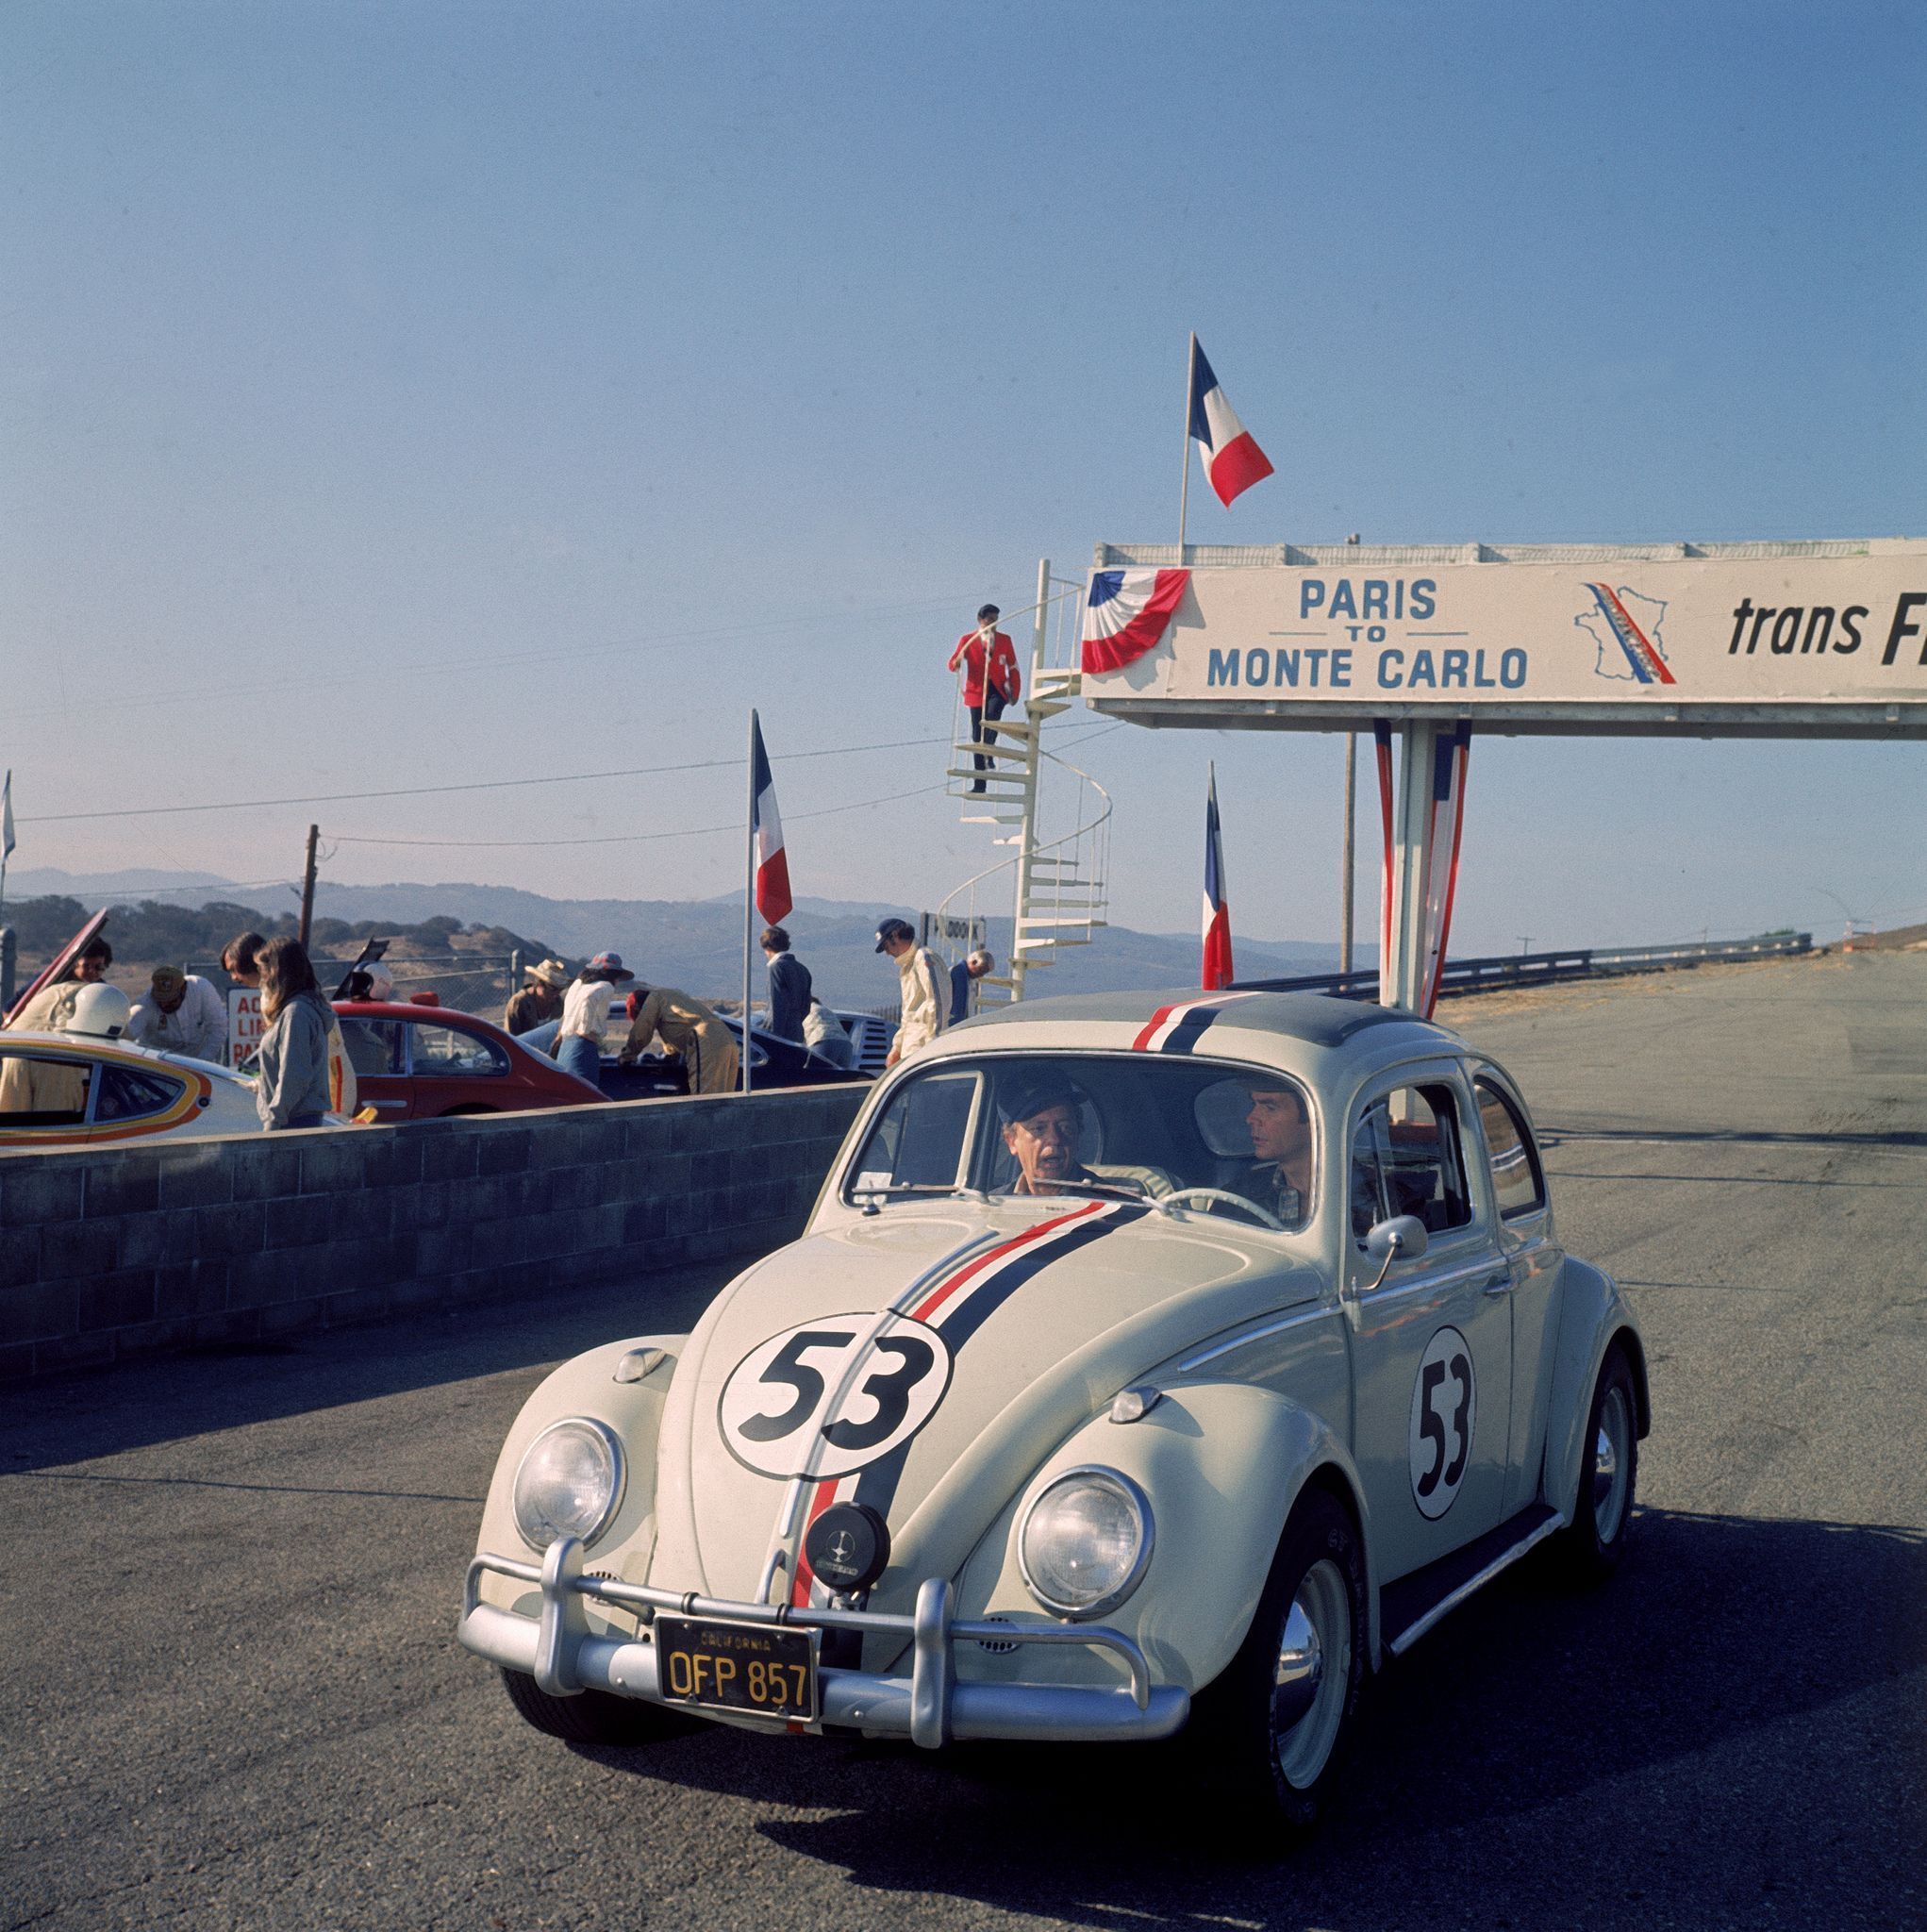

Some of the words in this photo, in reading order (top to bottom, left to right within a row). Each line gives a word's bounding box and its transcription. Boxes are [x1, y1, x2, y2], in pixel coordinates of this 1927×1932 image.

[1300, 578, 1437, 620] PARIS
[1344, 625, 1387, 642] TO
[1728, 597, 1869, 655] trans
[1881, 592, 1927, 666] F
[1207, 648, 1353, 688] MONTE
[1377, 647, 1528, 689] CARLO
[737, 1331, 935, 1451] 53
[1417, 1353, 1471, 1498] 53
[701, 1629, 772, 1652] CALIFORNIA
[669, 1651, 738, 1698] OFP
[747, 1660, 806, 1707] 857
